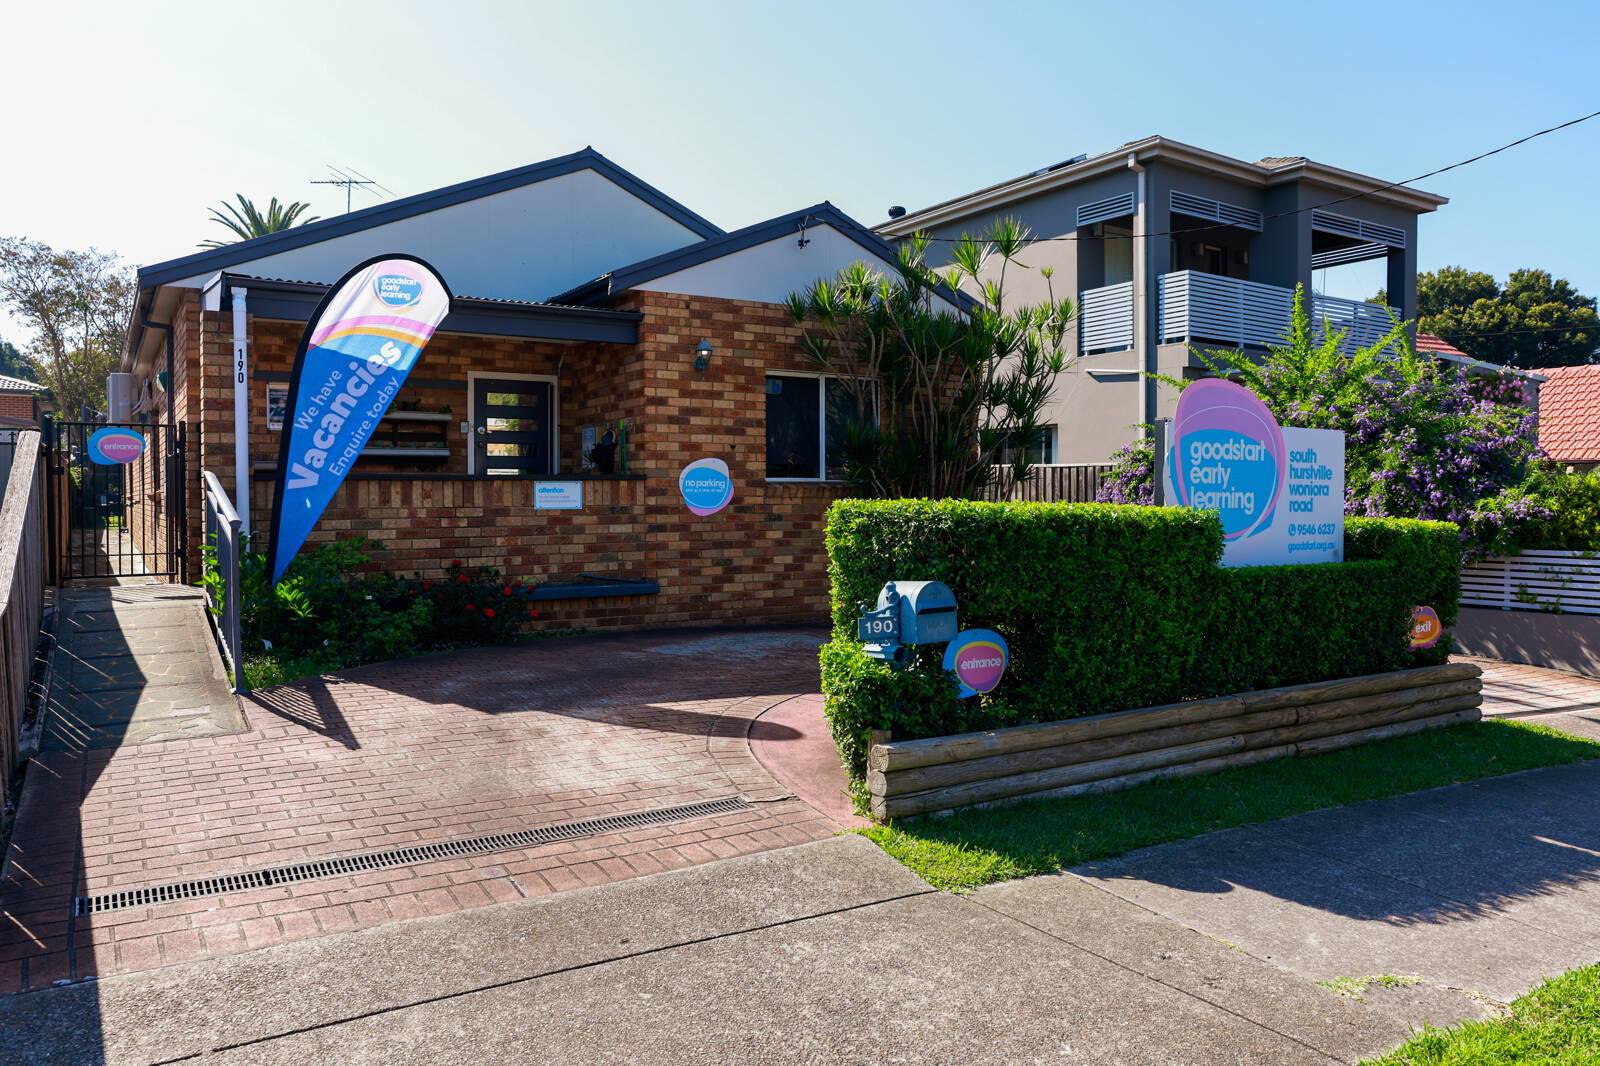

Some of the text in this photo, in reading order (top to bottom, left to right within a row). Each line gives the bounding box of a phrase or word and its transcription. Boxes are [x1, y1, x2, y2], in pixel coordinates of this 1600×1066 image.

[381, 277, 417, 286] goodstart
[381, 284, 400, 292] early
[381, 291, 411, 300] learning
[295, 370, 342, 431] We have
[287, 341, 401, 490] Vacancies
[328, 377, 399, 476] Enquire today
[1190, 438, 1265, 465] goodstart
[1289, 448, 1317, 464] south
[1190, 463, 1231, 489] early
[1289, 464, 1333, 481] hurstville
[696, 479, 726, 489] parking
[1289, 482, 1330, 497] woniora
[1190, 486, 1255, 515] learning
[1289, 498, 1313, 513] road
[1297, 524, 1336, 536] 9546 6237
[1288, 540, 1336, 553] goodstart.org.au
[865, 620, 893, 634] 190
[1415, 620, 1431, 633] exit
[961, 657, 1002, 670] entrance
